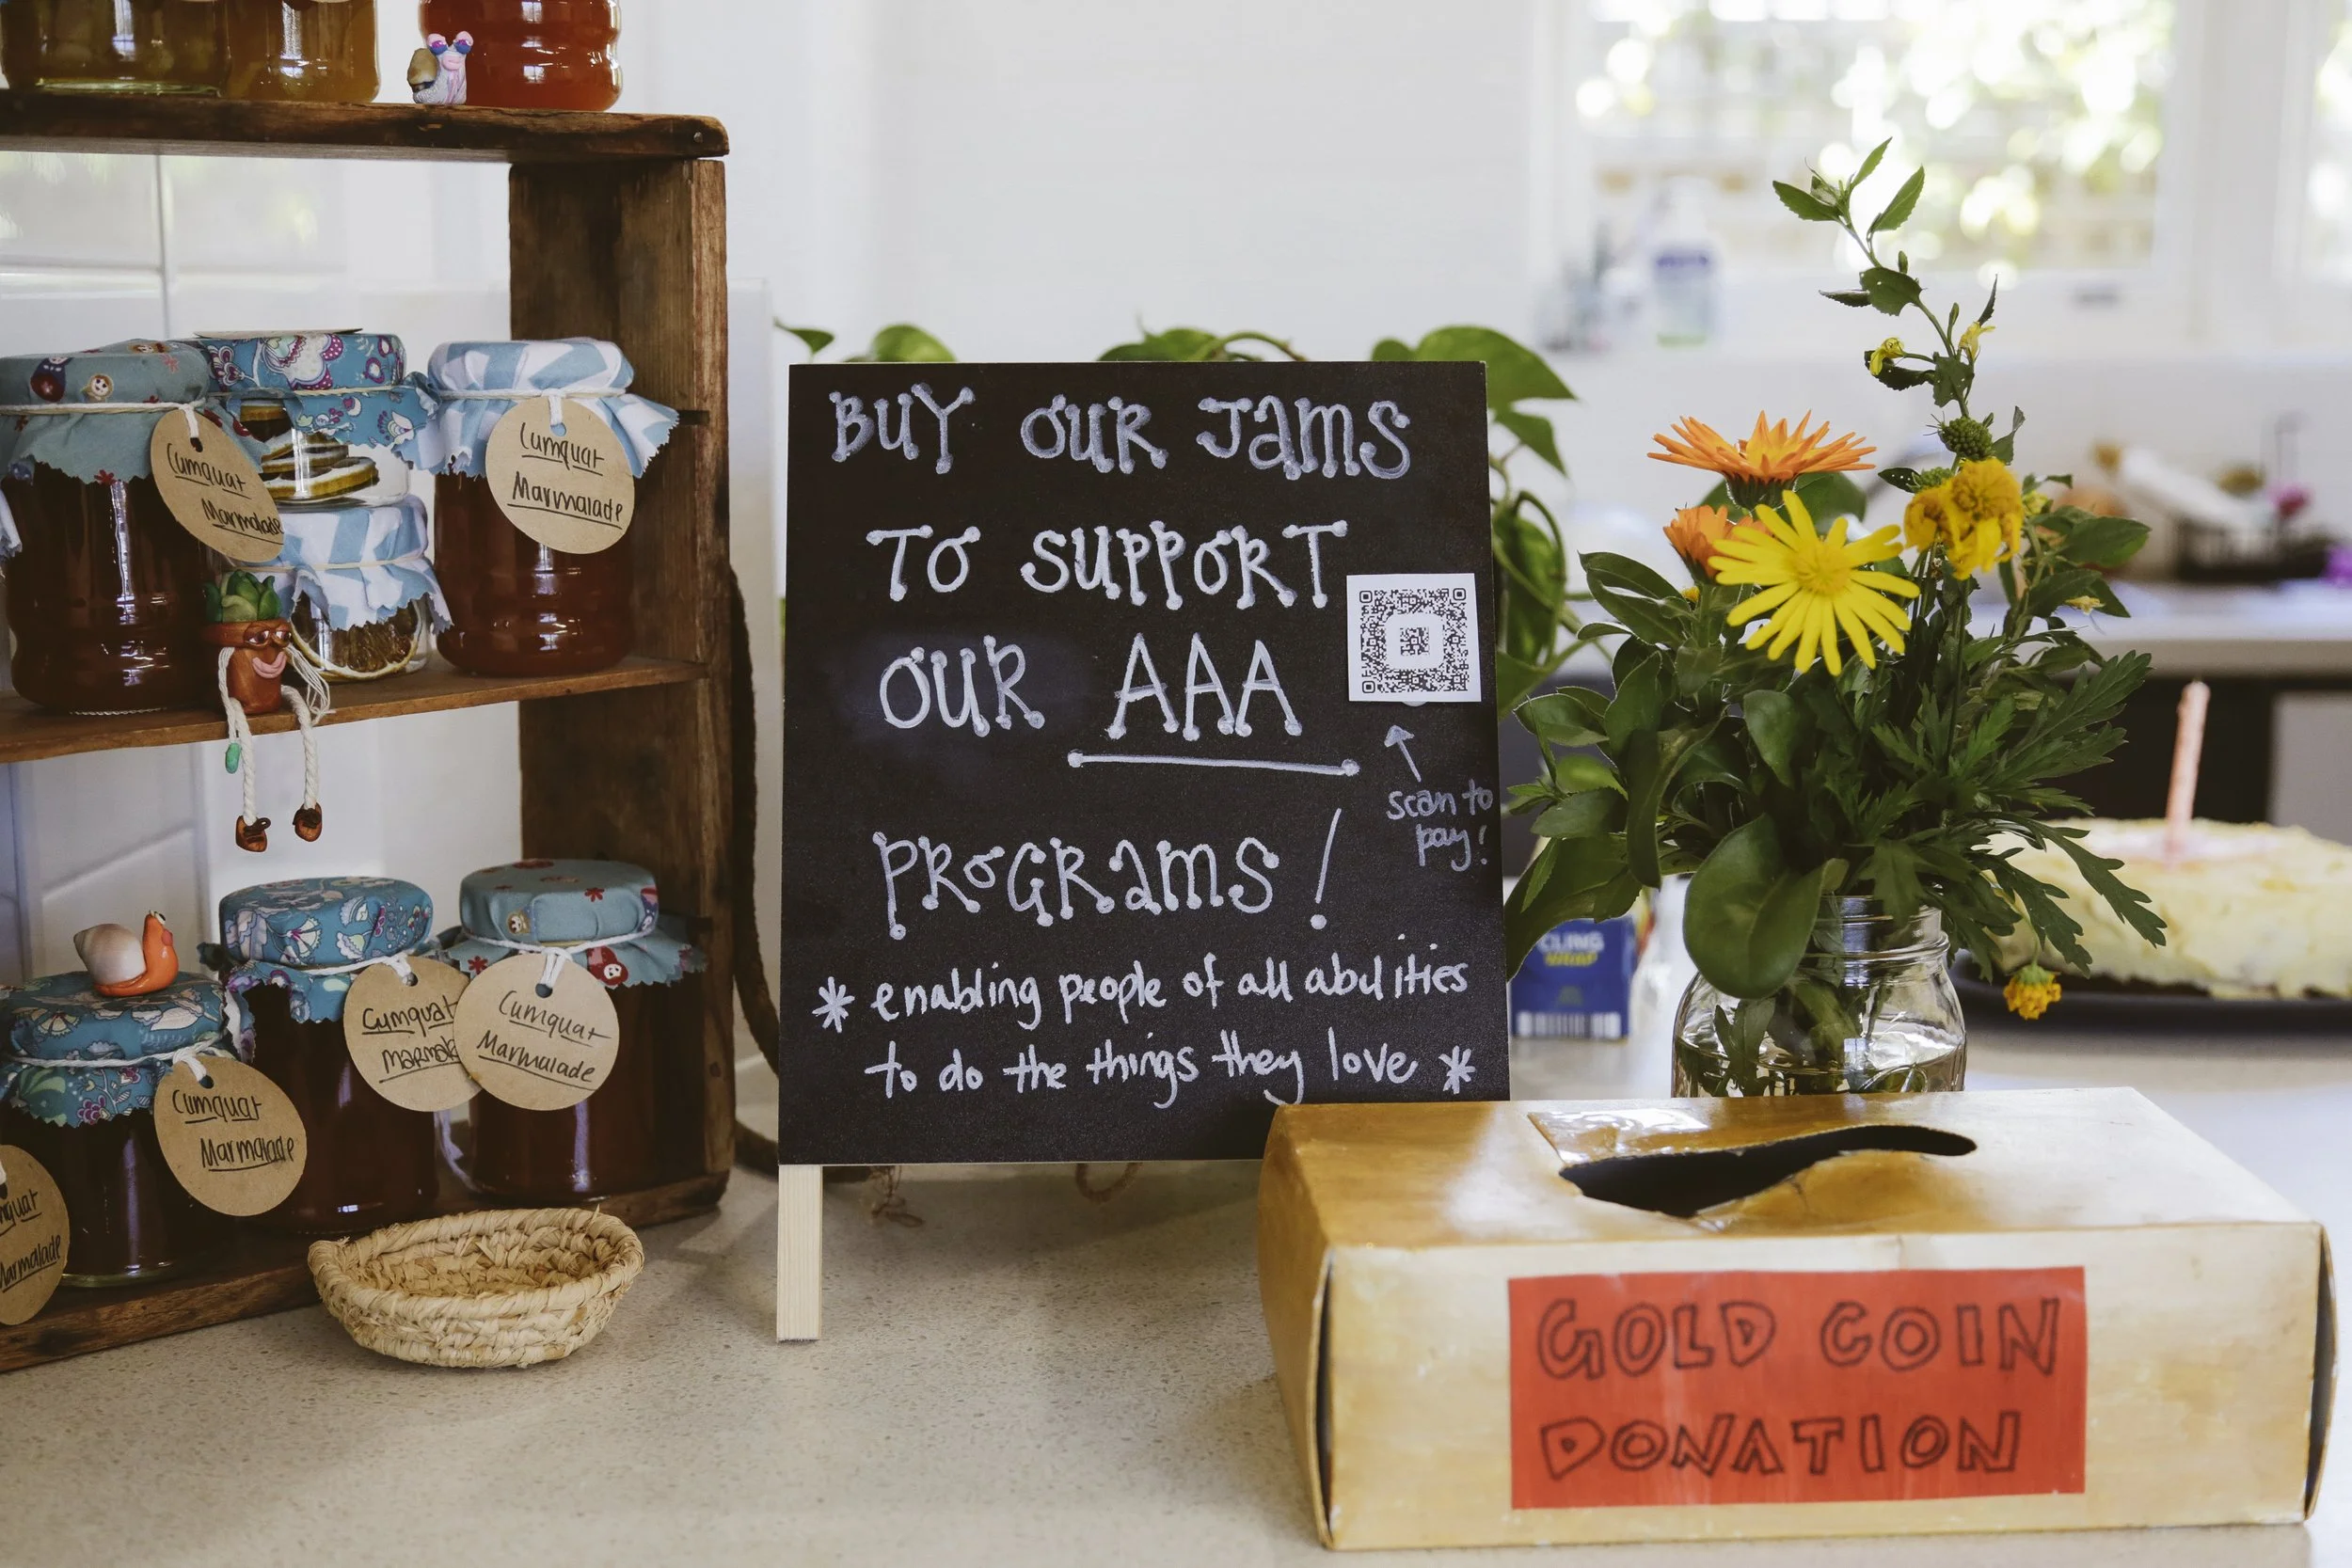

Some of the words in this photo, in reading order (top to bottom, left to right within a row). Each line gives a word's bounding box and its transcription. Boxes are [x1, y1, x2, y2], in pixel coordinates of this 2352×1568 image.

[520, 422, 604, 470] Cumquat
[829, 384, 975, 474] BUY
[1020, 394, 1167, 474] OUR
[167, 443, 246, 491] Cumquat
[201, 498, 284, 535] Marmalade
[513, 471, 623, 521] Marmalade
[866, 524, 981, 602] TO
[1020, 519, 1347, 610] SUPPORT
[879, 634, 1046, 738] OUR
[1104, 632, 1303, 742] AAA
[1386, 789, 1457, 820] scan
[1461, 778, 1494, 816] to
[1415, 823, 1488, 872] pay!
[499, 990, 612, 1040] Cumquat
[871, 961, 1042, 1032] enabling
[1058, 959, 1168, 1025] people
[1181, 951, 1225, 1010] of
[1237, 956, 1294, 1004] all
[476, 1030, 596, 1083] Marmalade
[864, 1039, 917, 1099] to
[938, 1048, 984, 1092] do
[1002, 1043, 1068, 1094] the
[1085, 1031, 1200, 1109] things
[1211, 1029, 1305, 1104] they
[1327, 1026, 1419, 1085] love
[172, 1089, 262, 1122] Cumquat
[200, 1135, 294, 1168] Marmalade
[1536, 1298, 1777, 1380] GOLD
[1819, 1296, 2060, 1377] COIN
[1538, 1411, 2022, 1481] DONATION
